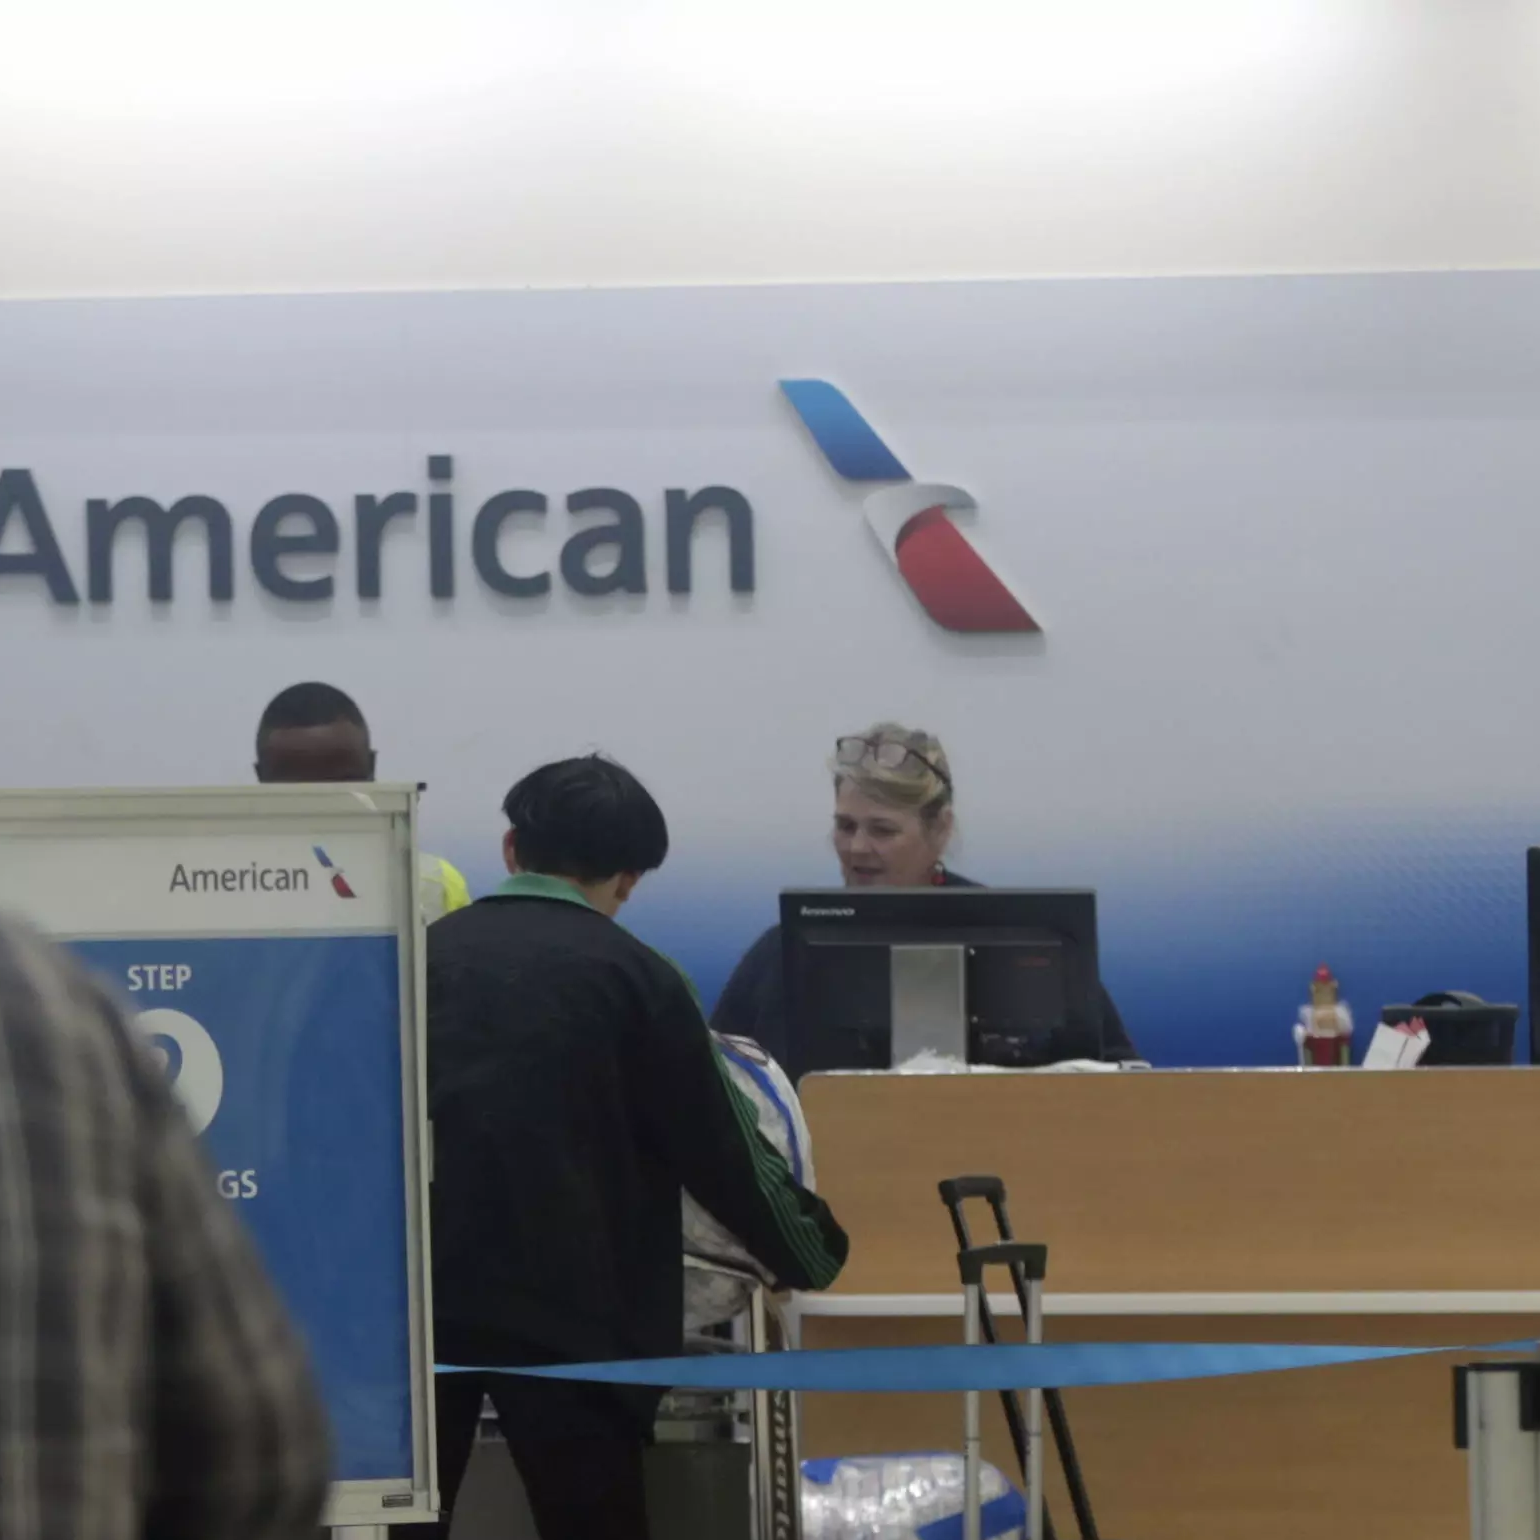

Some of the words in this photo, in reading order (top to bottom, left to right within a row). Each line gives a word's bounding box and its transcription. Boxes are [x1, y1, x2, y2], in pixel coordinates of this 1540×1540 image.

[169, 862, 309, 893] American
[127, 964, 192, 991] STEP
[217, 1169, 258, 1200] GS
